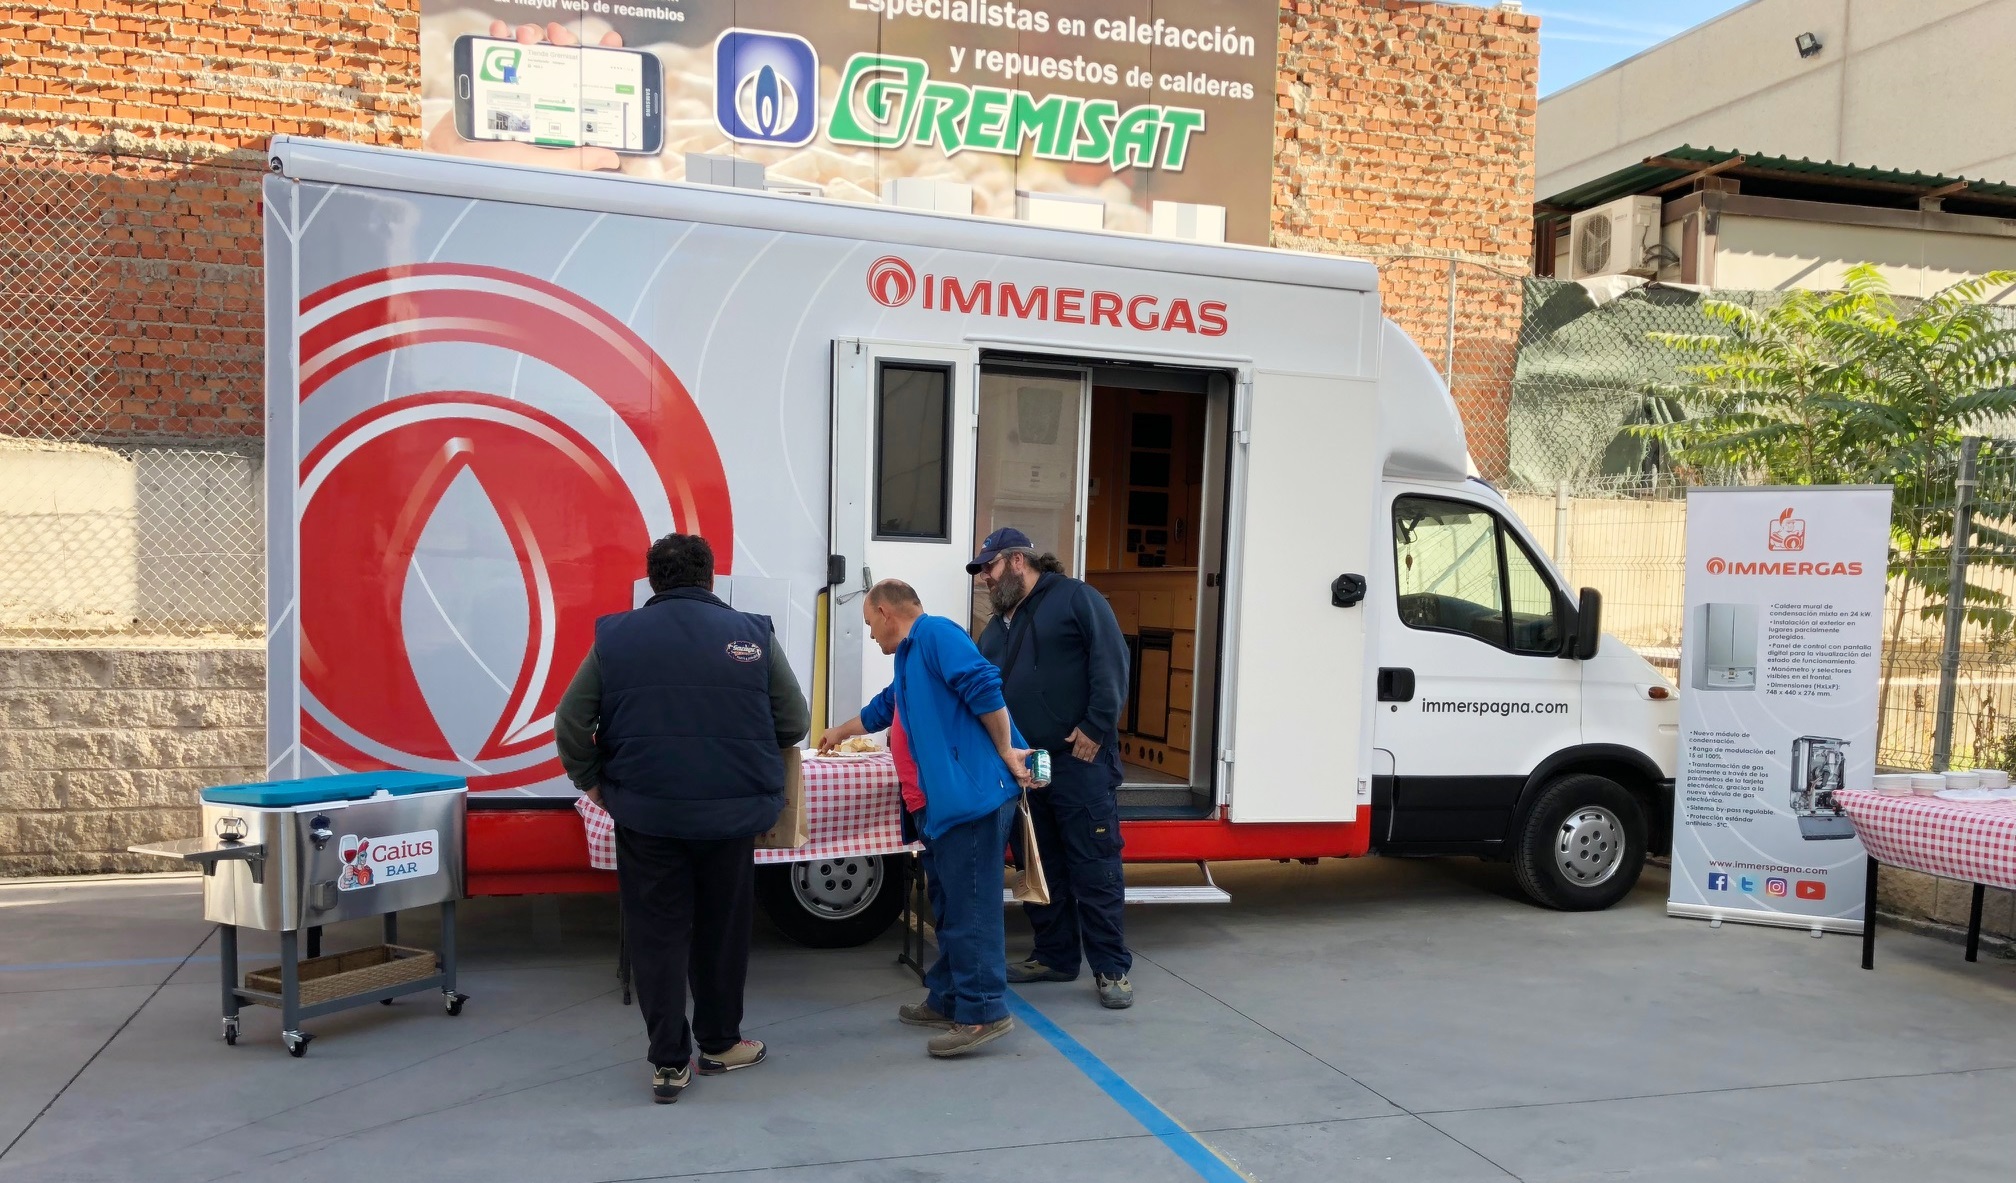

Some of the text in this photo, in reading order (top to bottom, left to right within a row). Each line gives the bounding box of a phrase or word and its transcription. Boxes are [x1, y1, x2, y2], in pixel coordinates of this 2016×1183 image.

[561, 0, 589, 11] web
[593, 0, 610, 13] de
[614, 5, 685, 22] recambios
[1058, 15, 1086, 36] en
[1093, 17, 1255, 56] calefacción
[528, 49, 549, 58] Tienda
[950, 45, 1254, 100] y repuestos de calderas
[826, 52, 1206, 172] GREMISAT
[922, 273, 1228, 336] IMMERGAS
[1728, 562, 1863, 576] IMMERGAS
[1422, 698, 1568, 716] immerspagna.com
[372, 840, 433, 862] Caius
[386, 862, 417, 876] BAR
[1709, 860, 1828, 875] www.immerspagna.com
